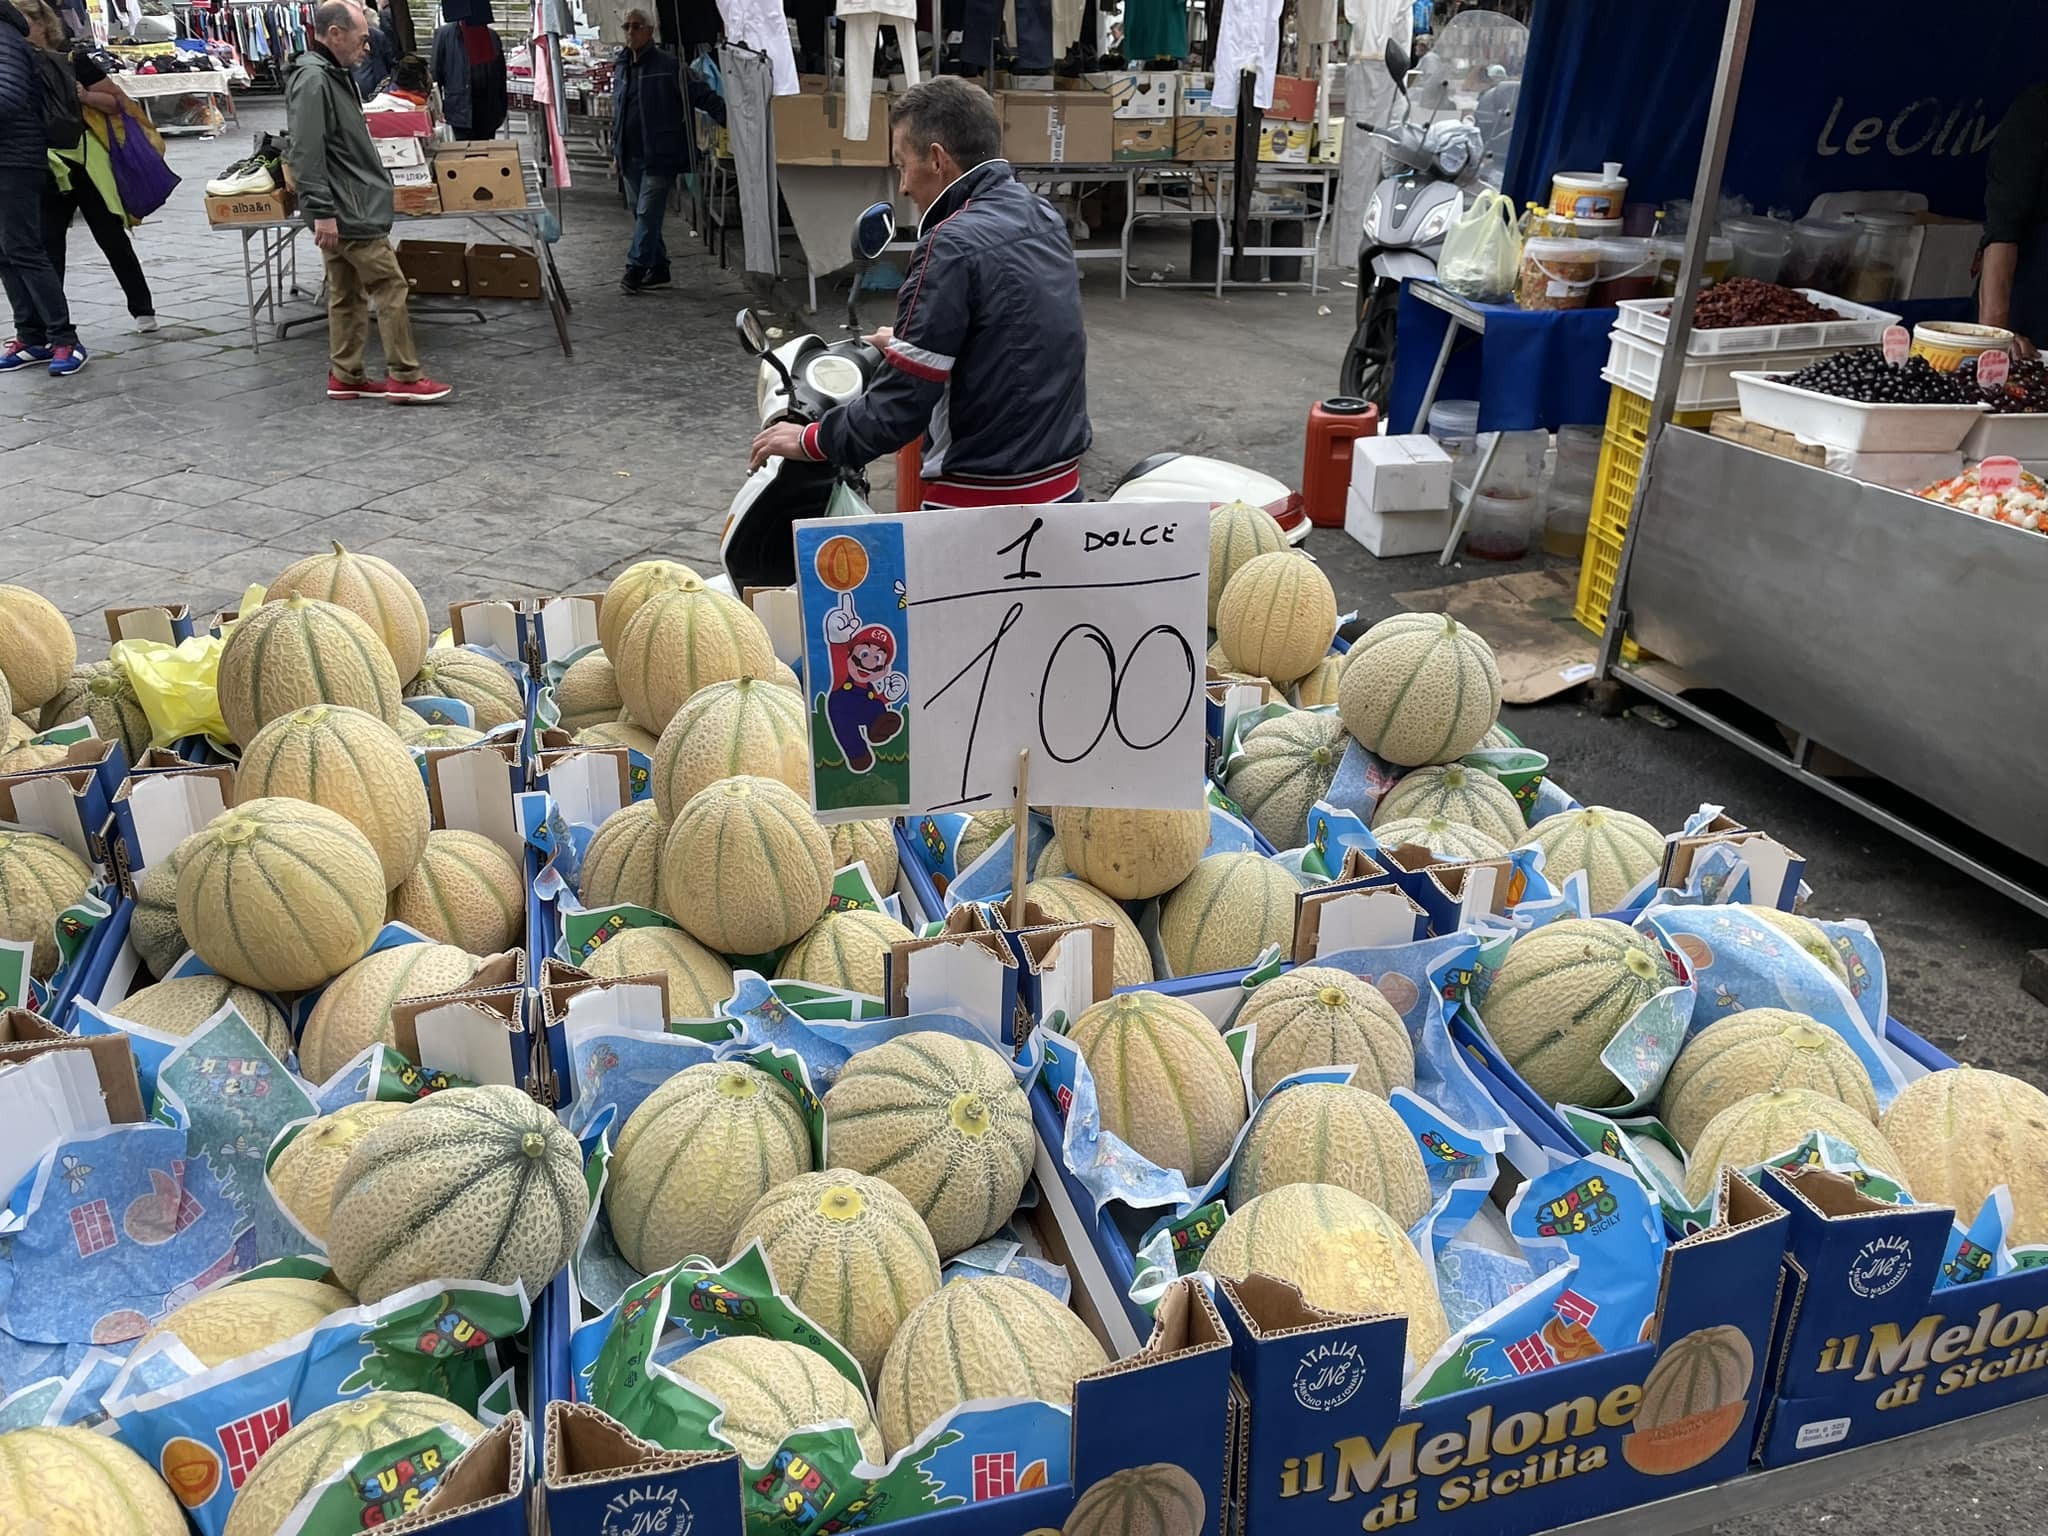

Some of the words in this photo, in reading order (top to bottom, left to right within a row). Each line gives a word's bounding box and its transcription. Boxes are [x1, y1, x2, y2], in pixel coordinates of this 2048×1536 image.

[232, 203, 272, 214] alba&n
[996, 517, 1043, 579] 1
[1083, 523, 1179, 553] DOLCE
[582, 914, 625, 957] SUPER
[1539, 1178, 1605, 1223] SUPER
[1539, 1196, 1616, 1237] GUSTO
[1591, 1212, 1622, 1237] SICILY
[1860, 1235, 1909, 1258] ITALIA
[690, 1292, 757, 1316] GUSTO
[1300, 1341, 1358, 1367] ITALIA
[1816, 1335, 1860, 1373] il
[1299, 1378, 1322, 1407] MARCHIO
[1323, 1368, 1361, 1407] NAZIONALE
[1875, 1374, 1926, 1411] di
[1280, 1452, 1325, 1498] il
[1328, 1384, 1643, 1502] Melone
[363, 1448, 441, 1499] SUPER
[775, 1450, 837, 1511] SUPE
[1362, 1489, 1418, 1532] di
[1438, 1445, 1609, 1512] Sicilia
[606, 1485, 678, 1513] ITALIA
[755, 1473, 819, 1525] GUST
